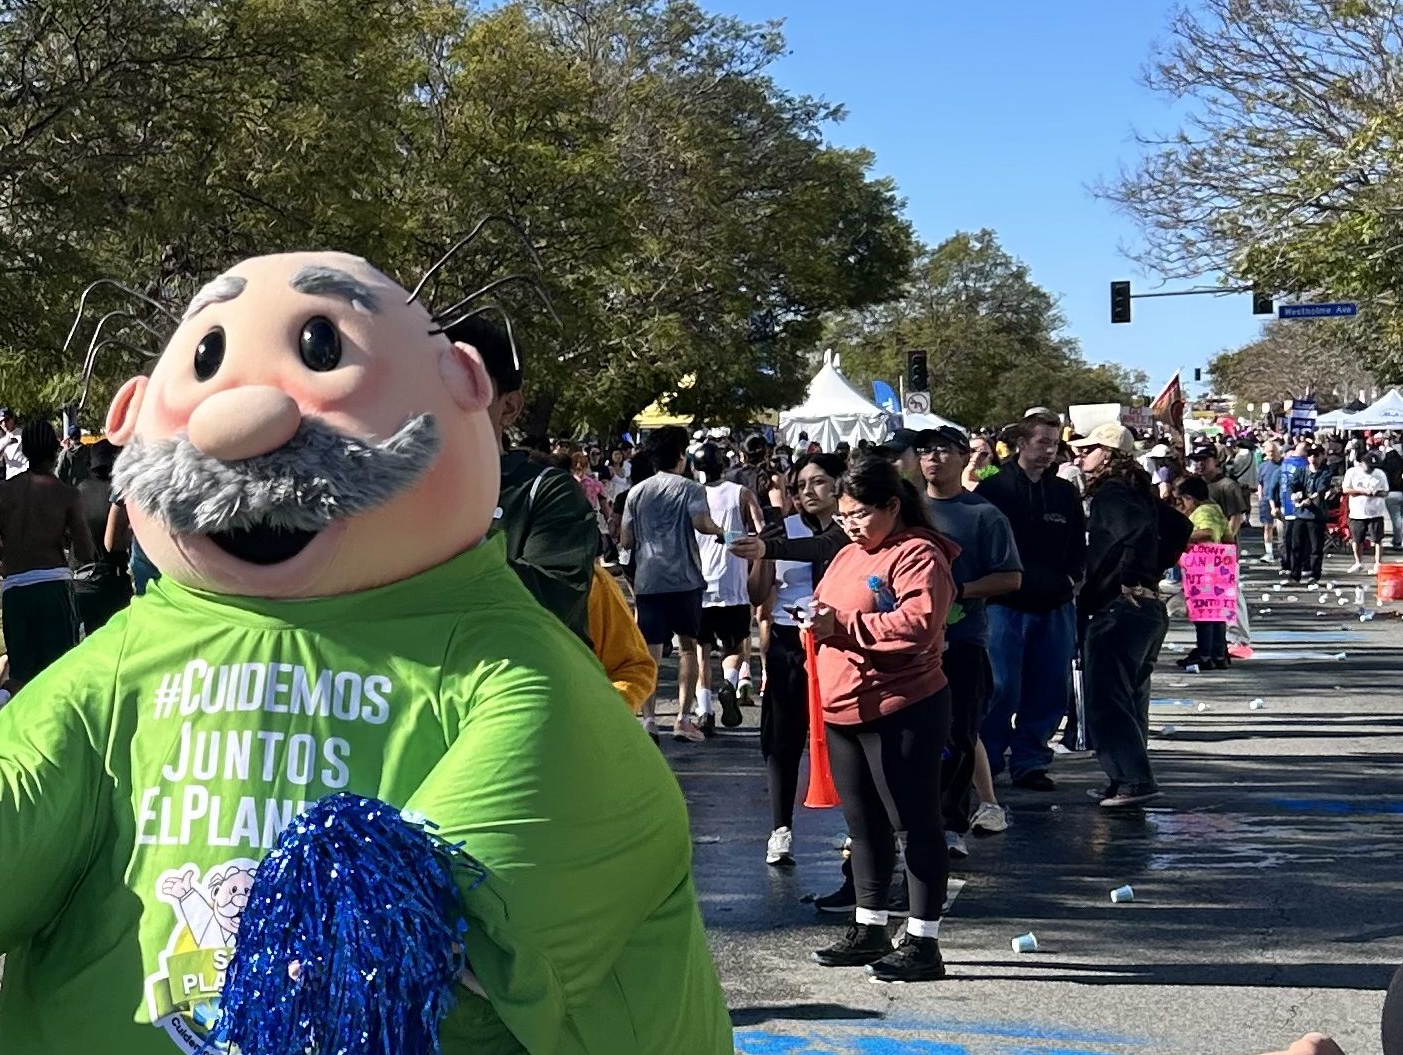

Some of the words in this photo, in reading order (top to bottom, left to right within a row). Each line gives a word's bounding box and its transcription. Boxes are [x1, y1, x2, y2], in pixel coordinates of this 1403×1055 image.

[1284, 306, 1332, 316] Westholme
[1335, 305, 1352, 314] Ave
[1185, 556, 1206, 567] CAN
[1214, 556, 1233, 566] DO
[154, 658, 392, 725] #CUIDEMOS
[162, 721, 350, 789] JUNTOS
